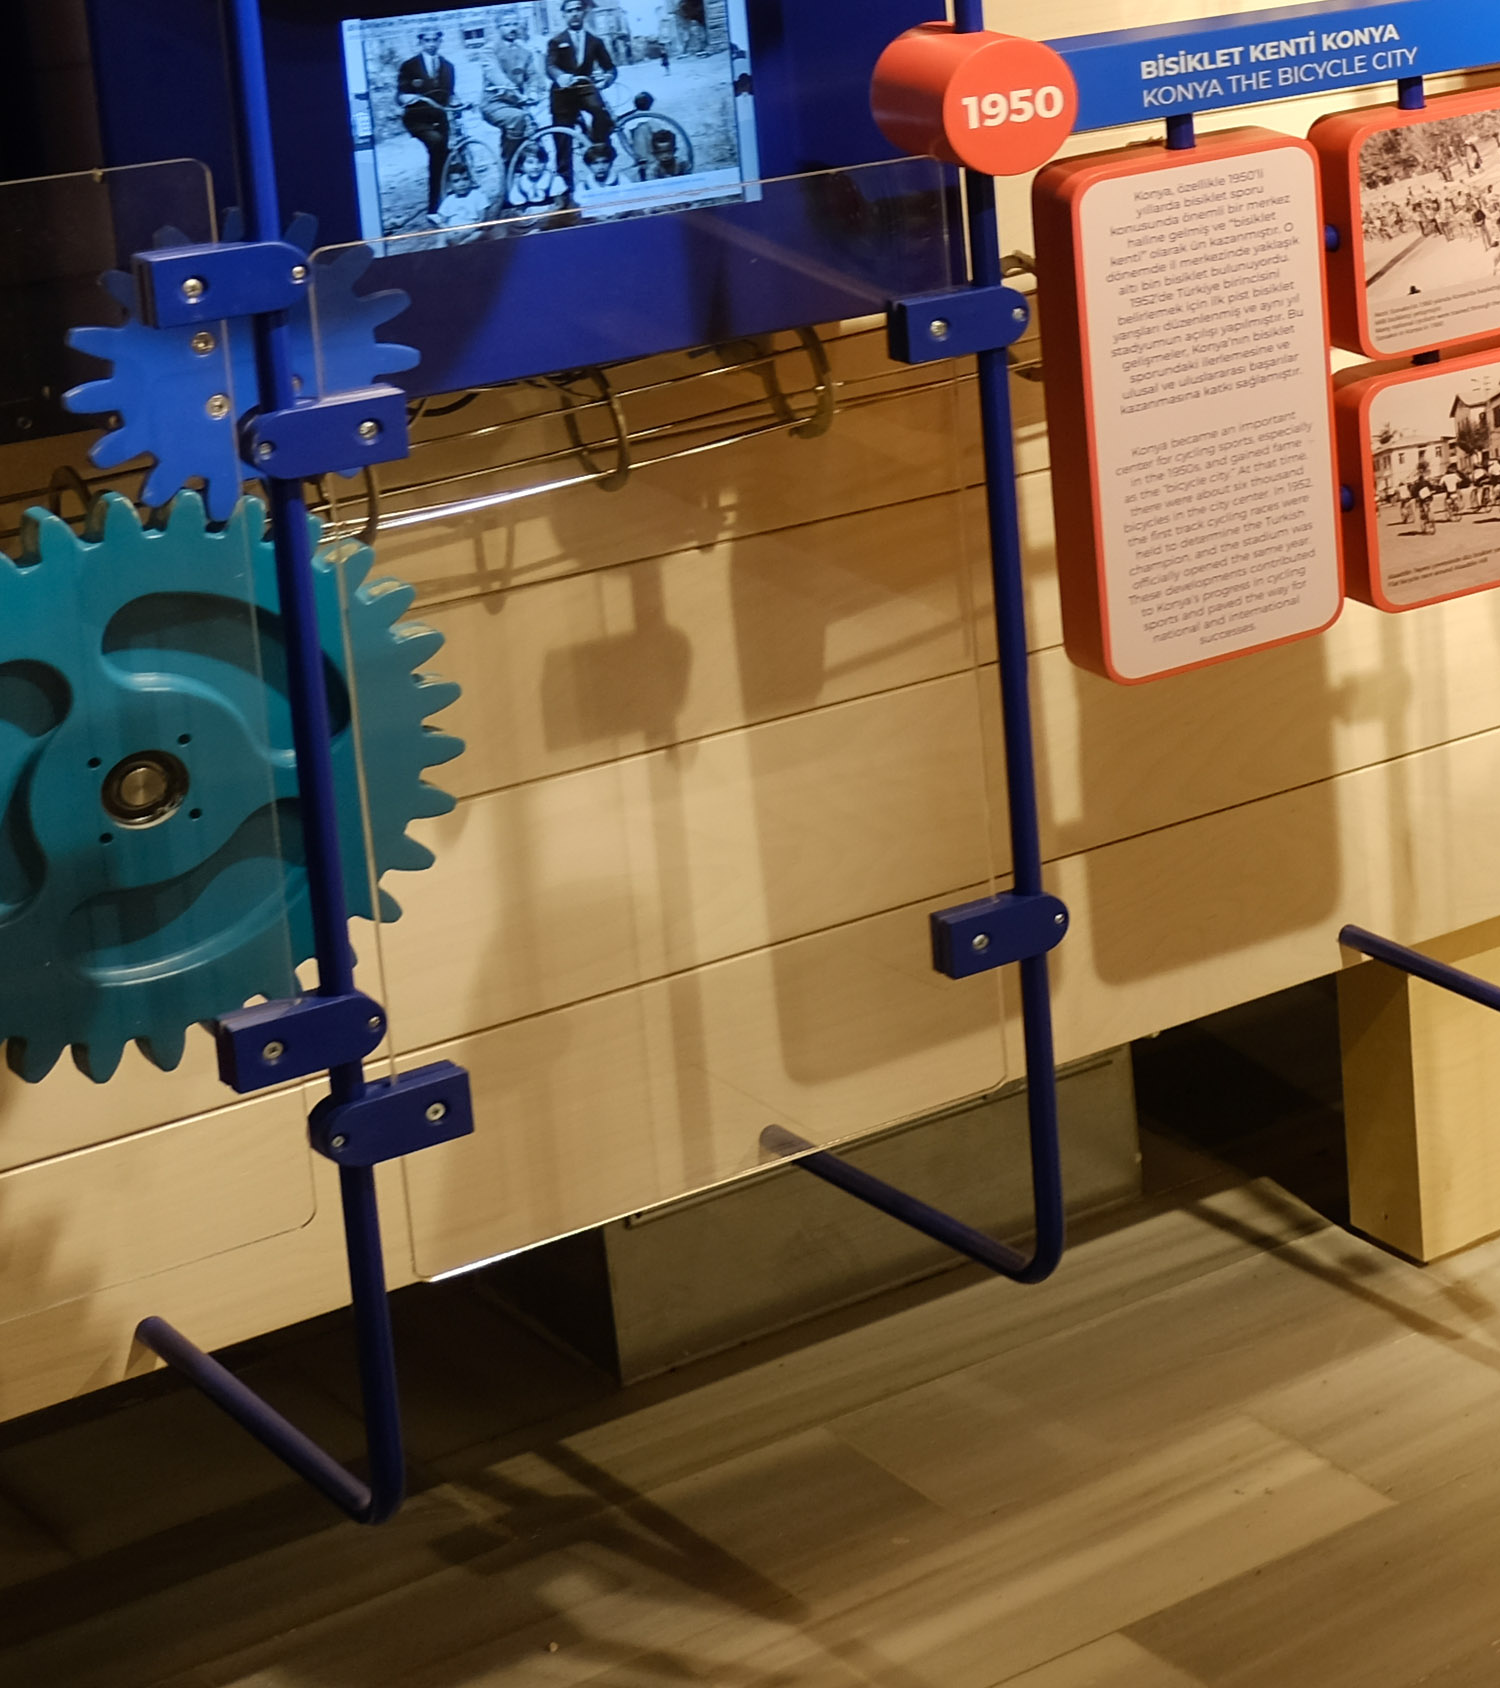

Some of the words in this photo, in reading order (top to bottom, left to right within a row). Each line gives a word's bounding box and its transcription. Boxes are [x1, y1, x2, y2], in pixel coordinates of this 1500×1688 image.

[1140, 46, 1244, 78] BİSİKLET
[1248, 36, 1316, 62] KENTİ
[1321, 23, 1400, 50] KONYA
[1142, 79, 1224, 106] KONYA
[1230, 69, 1272, 93] THE
[1277, 54, 1368, 85] BICYCLE
[1371, 46, 1416, 70] CITY
[961, 86, 1065, 131] 1950
[1176, 177, 1225, 192] özellikle
[1183, 191, 1226, 206] bisiklet
[1230, 186, 1263, 199] sporu
[1110, 216, 1179, 235] konusunda
[1182, 206, 1224, 221] önemli
[1227, 203, 1243, 213] bir
[1247, 195, 1290, 209] merkez
[1105, 263, 1166, 281] dönemde
[1179, 246, 1250, 267] merkezinde
[1252, 235, 1298, 255] yaklaşık
[1118, 284, 1136, 294] altı
[1141, 279, 1160, 289] bin
[1164, 269, 1208, 285] bisiklet
[1129, 292, 1173, 308] 1952'de
[1176, 283, 1220, 297] Türkiye
[1223, 268, 1279, 288] birincisini
[1131, 442, 1167, 456] Konya
[1170, 430, 1218, 447] became
[1220, 426, 1235, 435] an
[1239, 410, 1295, 431] important
[1129, 503, 1162, 516] there
[1164, 495, 1193, 507] were
[1195, 484, 1230, 499] about
[1233, 480, 1247, 490] six
[1250, 465, 1304, 486] thousand
[1127, 535, 1148, 546] the
[1150, 528, 1172, 540] first
[1174, 519, 1203, 534] track
[1207, 510, 1247, 526] cycling
[1250, 502, 1280, 515] races
[1281, 494, 1309, 507] were
[1127, 591, 1161, 605] These
[1165, 568, 1247, 595] developments
[1249, 547, 1315, 572] contributed
[1131, 570, 1180, 589] officially
[1183, 556, 1227, 576] opened
[1230, 552, 1250, 563] the
[1252, 544, 1283, 557] same
[1152, 621, 1200, 642] national
[1203, 614, 1225, 628] and
[1228, 594, 1299, 621] international
